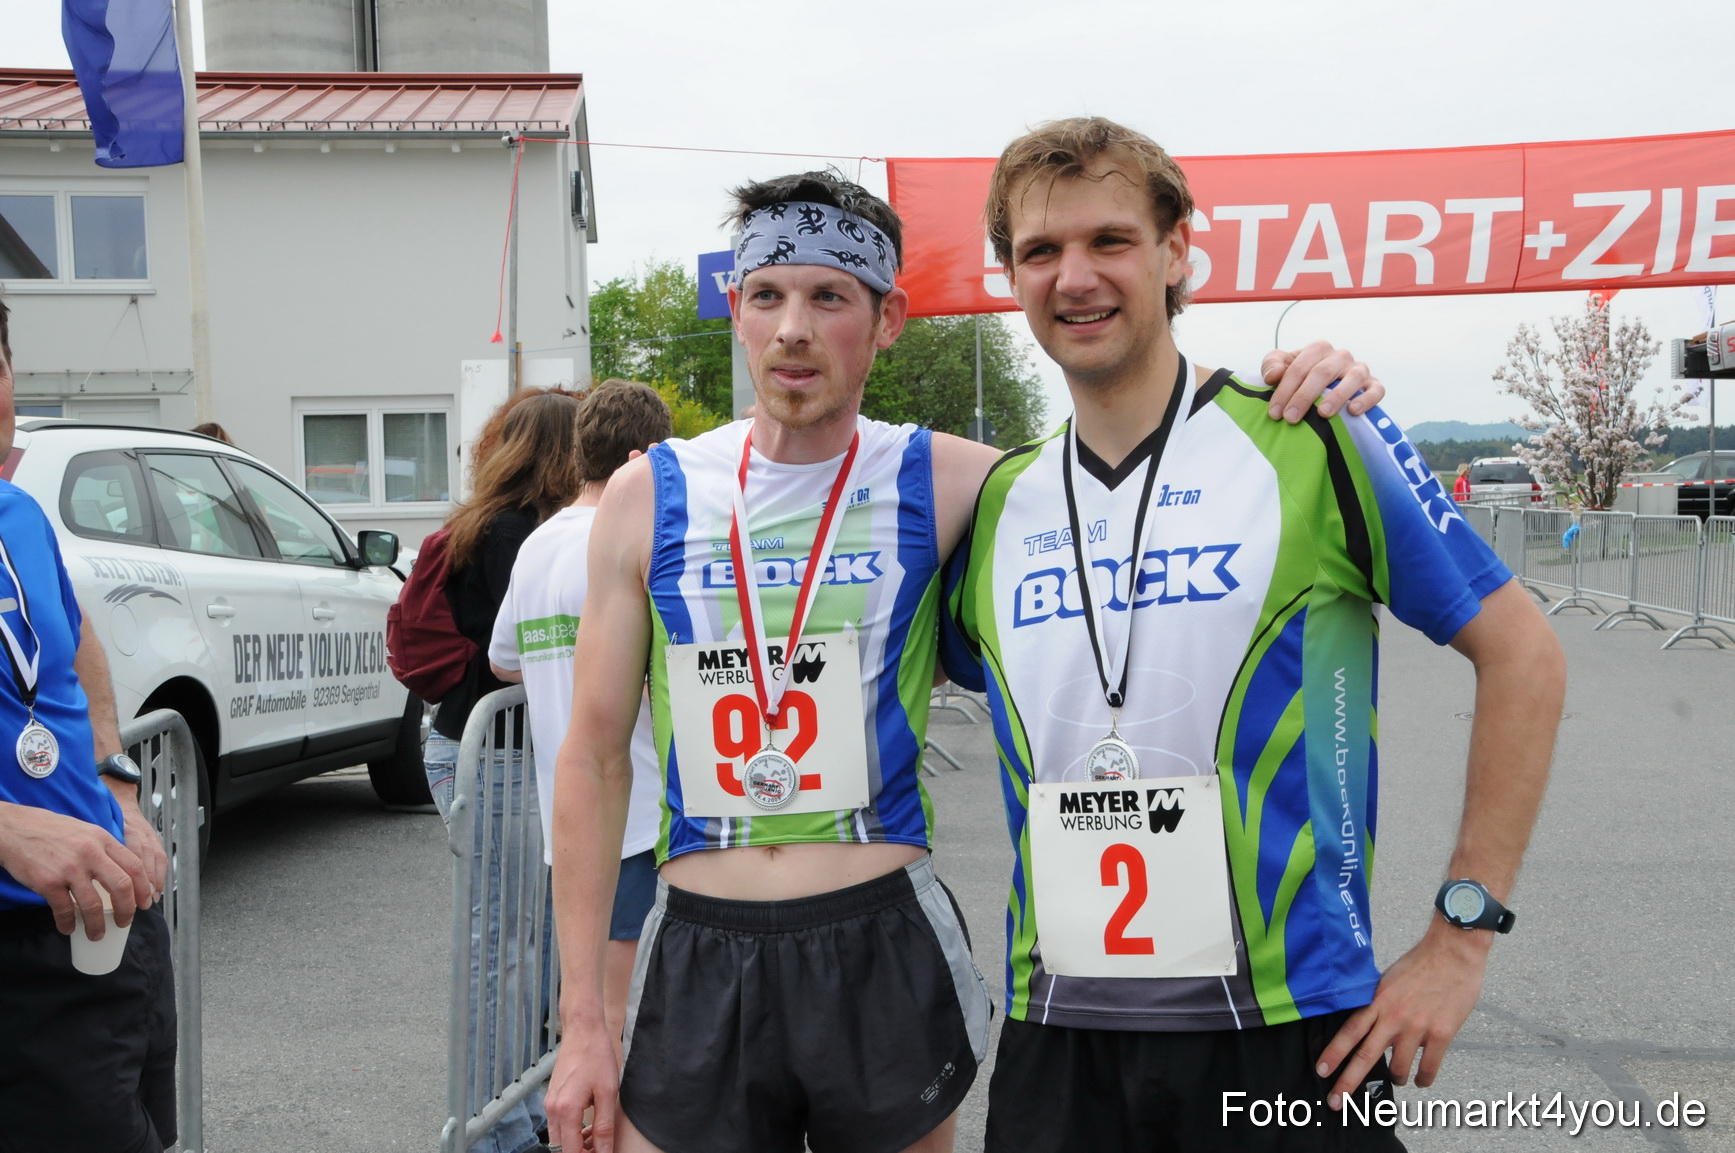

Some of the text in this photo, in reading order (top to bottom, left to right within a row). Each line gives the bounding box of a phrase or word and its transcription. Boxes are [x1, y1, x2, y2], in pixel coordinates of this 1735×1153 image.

[1350, 392, 1464, 534] OCK
[713, 537, 784, 551] TAM
[1024, 519, 1107, 556] TEAM
[703, 550, 884, 588] BOCK
[1013, 543, 1242, 629] BOCK
[233, 631, 387, 684] DER NEUE VOLVO XC60.
[698, 645, 785, 670] MEYR
[699, 666, 785, 685] WERBUG
[230, 680, 381, 719] GRAF Automobile 92369 Sengenthal
[712, 690, 822, 797] 92
[1060, 790, 1141, 814] MEYER
[1334, 667, 1366, 948] www.bockonline.de
[1060, 814, 1142, 831] WERBUNG
[1100, 843, 1155, 955] 2
